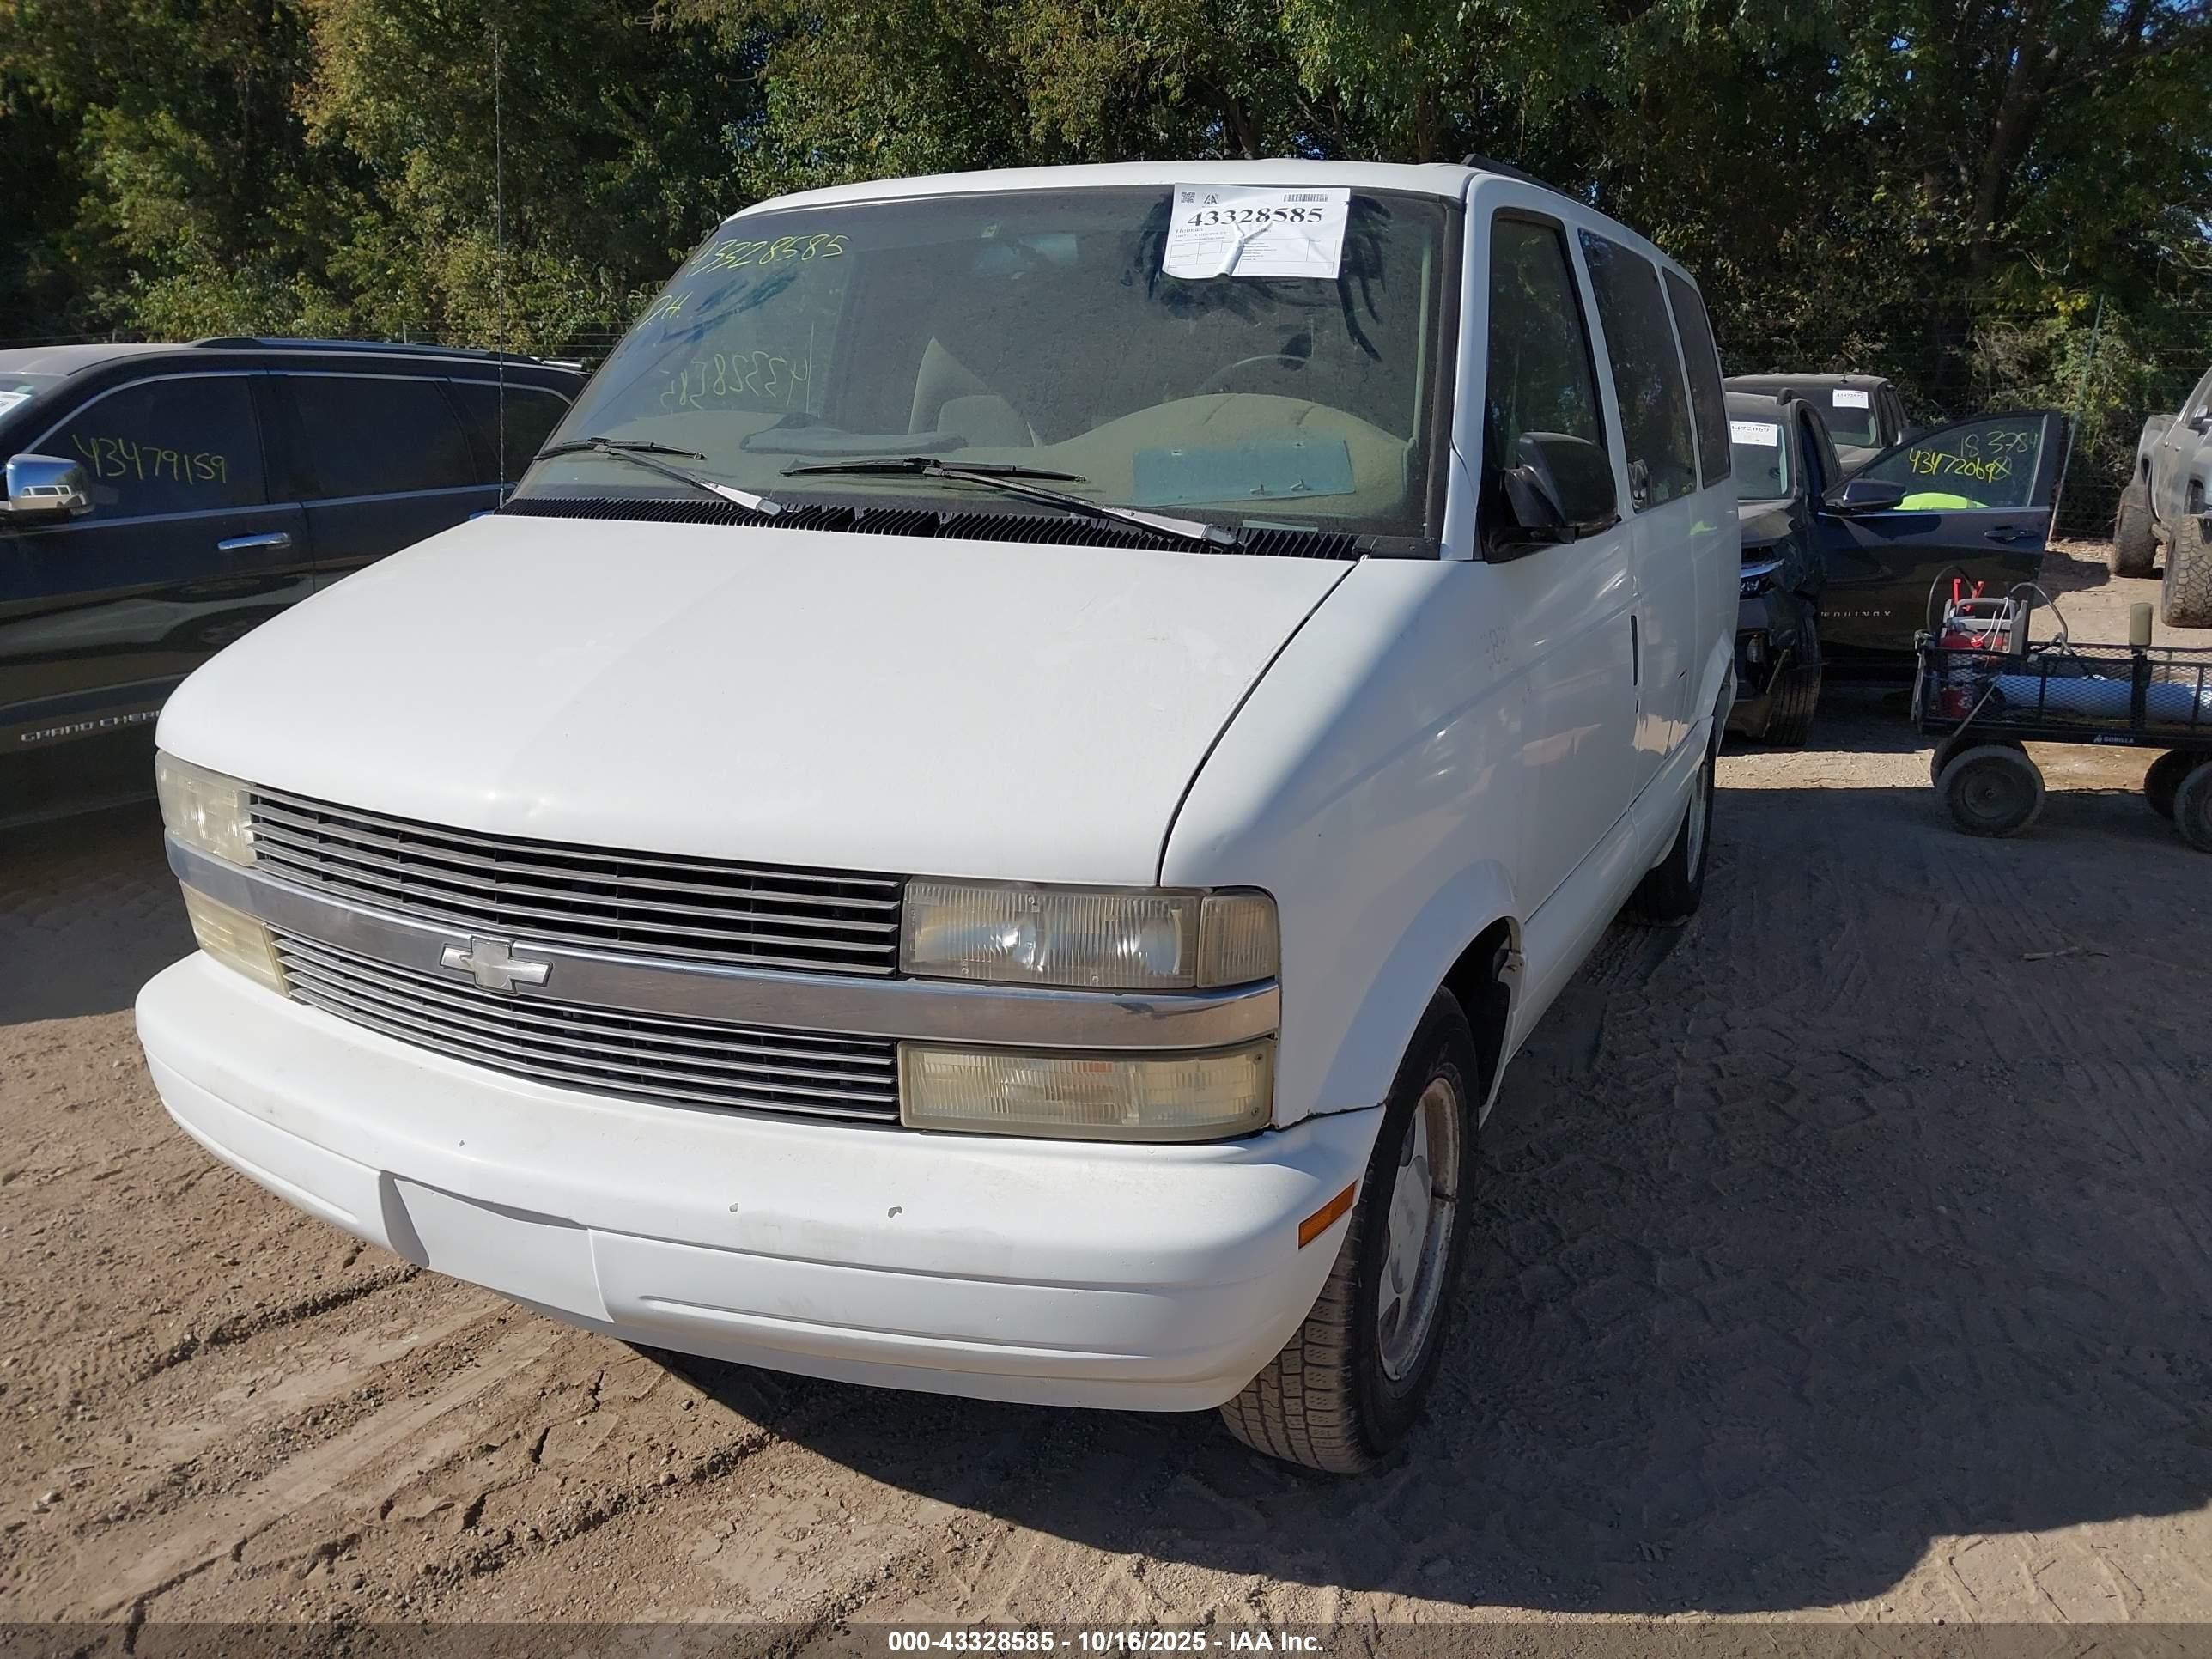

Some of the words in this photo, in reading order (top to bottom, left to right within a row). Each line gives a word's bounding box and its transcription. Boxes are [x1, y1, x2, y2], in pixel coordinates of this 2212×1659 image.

[1188, 207, 1323, 227] 43328585
[72, 433, 228, 484] 43479159
[1909, 447, 1997, 484] 43472069
[21, 721, 94, 743] GRAND
